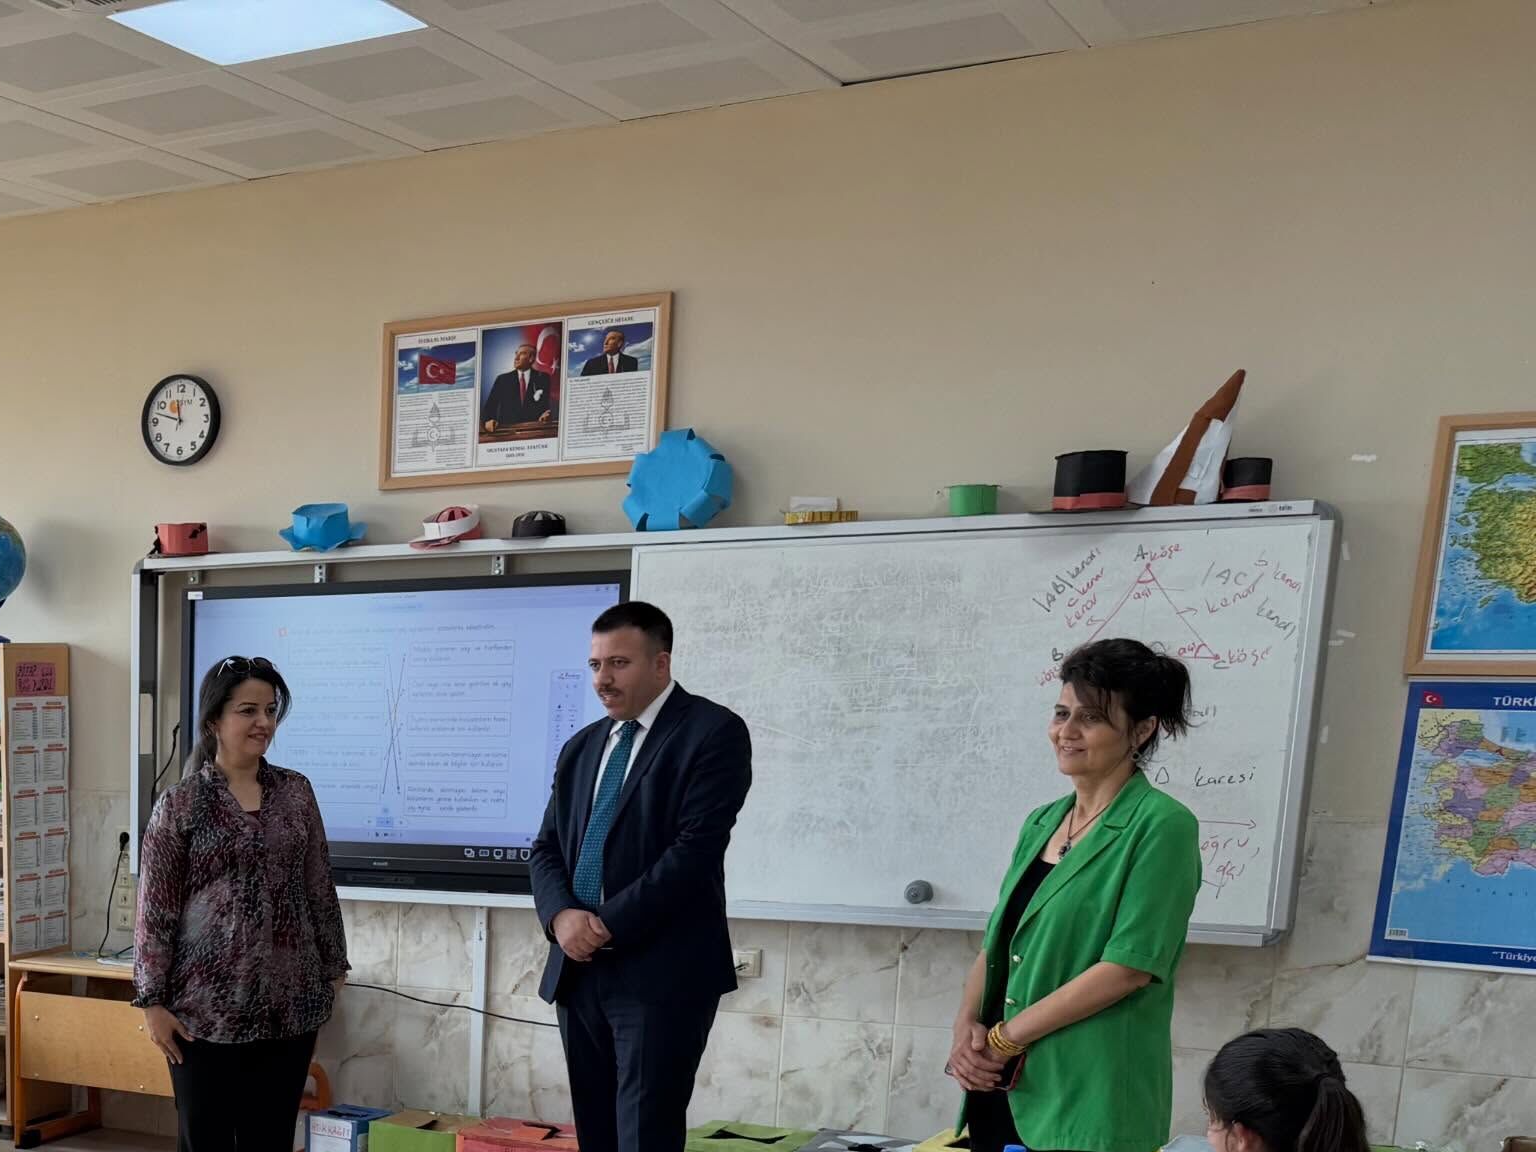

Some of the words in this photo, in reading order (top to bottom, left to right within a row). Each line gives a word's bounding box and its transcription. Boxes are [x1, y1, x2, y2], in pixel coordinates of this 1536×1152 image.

[177, 384, 186, 393] 12
[193, 388, 196, 397] 1
[165, 390, 172, 399] 11
[157, 400, 167, 410] 10
[199, 398, 206, 407] 2
[151, 417, 159, 427] 9
[203, 414, 210, 423] 3
[155, 433, 162, 442] 8
[199, 430, 205, 439] 4
[164, 443, 170, 452] 7
[190, 441, 197, 450] 5
[176, 446, 183, 455] 6
[1195, 766, 1257, 787] karesi
